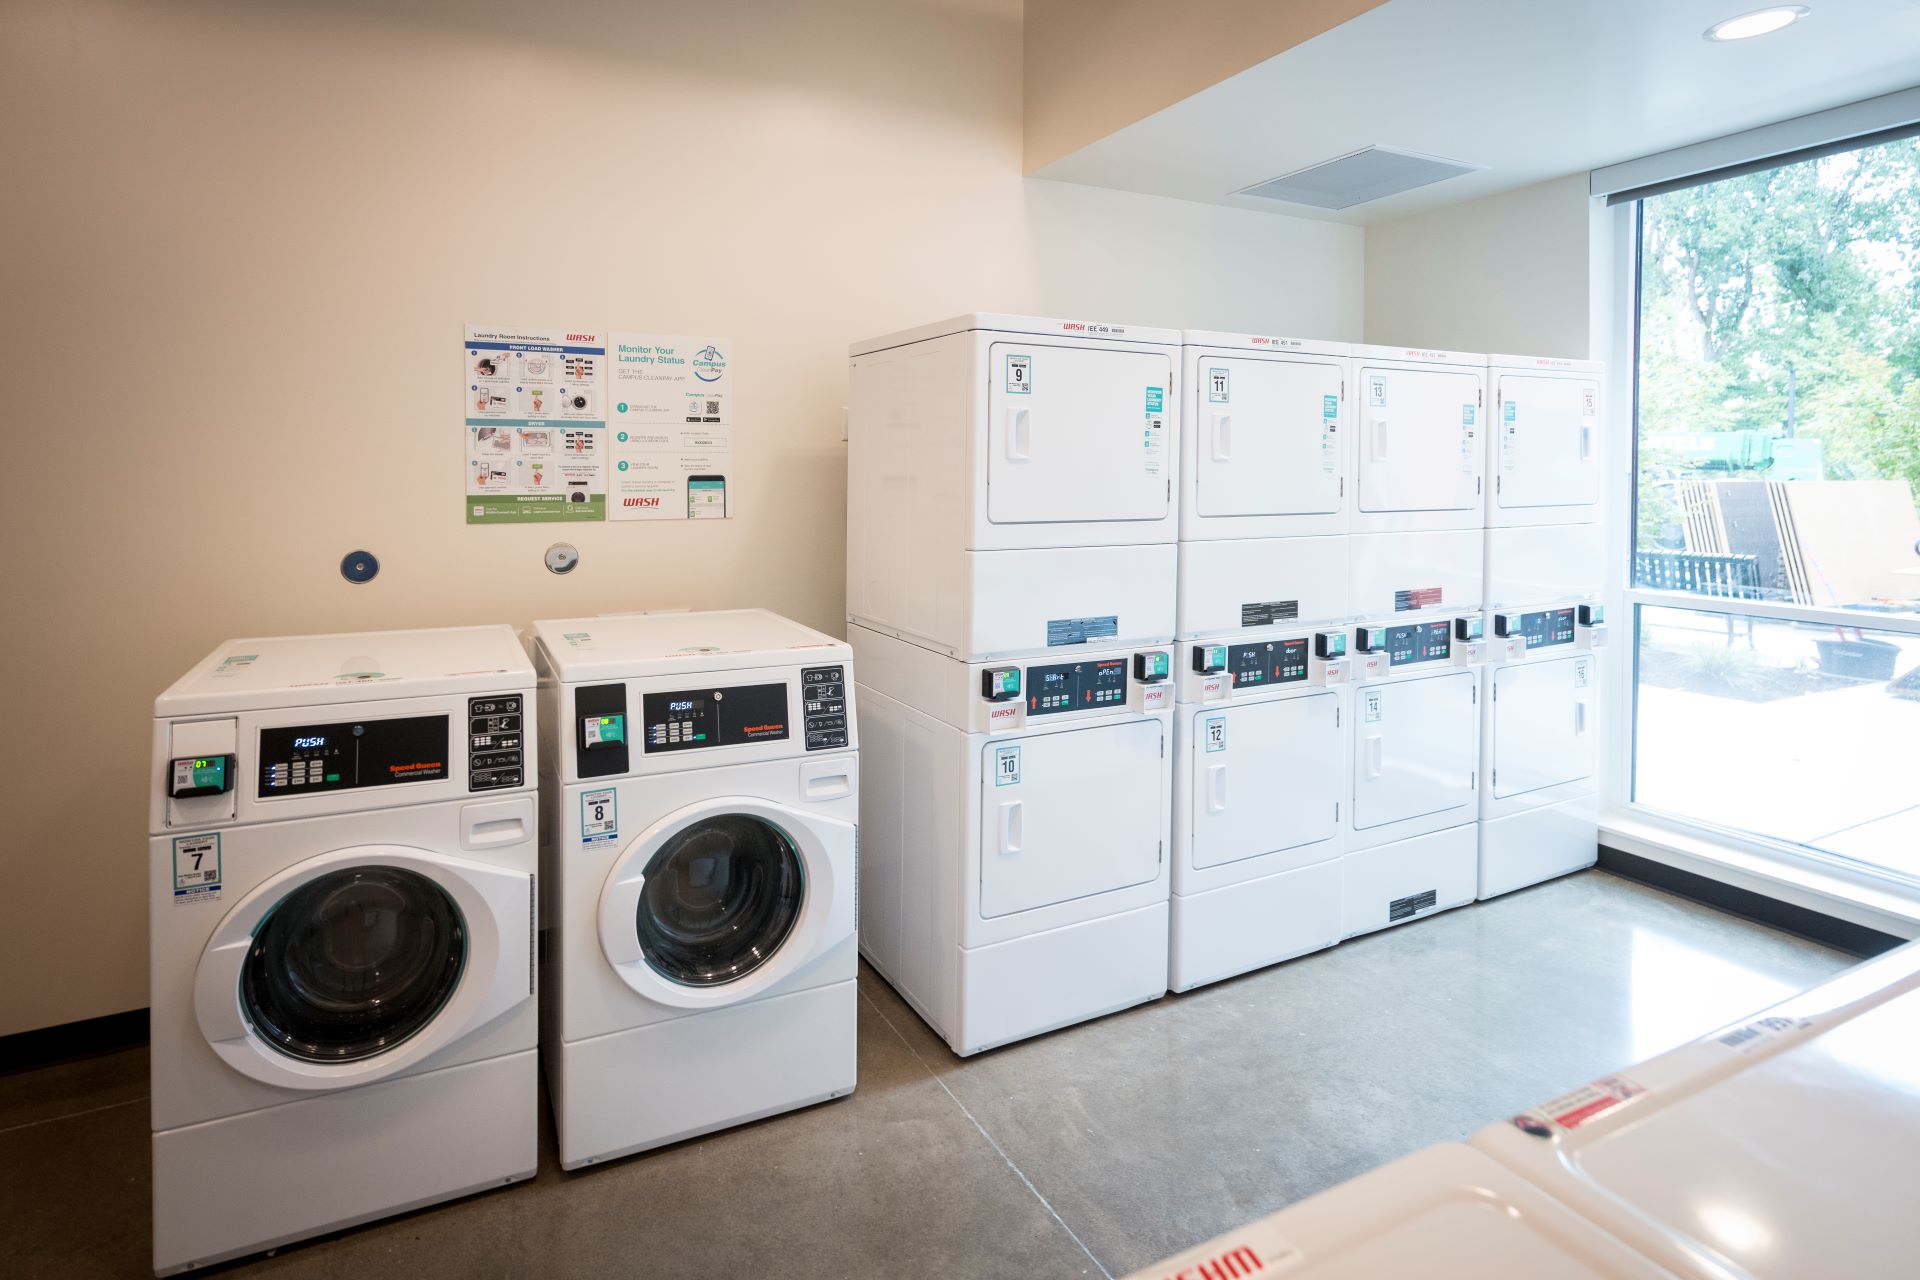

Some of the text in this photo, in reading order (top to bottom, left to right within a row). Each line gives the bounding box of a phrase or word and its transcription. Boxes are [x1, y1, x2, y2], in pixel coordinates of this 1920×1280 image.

[1063, 323, 1085, 331] WASH
[517, 334, 550, 342] Instructions
[566, 334, 595, 342] WASH
[618, 345, 674, 355] Monitor Your
[618, 355, 686, 366] Laundry Status
[693, 360, 726, 368] Campus
[1015, 368, 1022, 382] 9
[1214, 380, 1224, 392] 11
[1374, 386, 1382, 397] 13
[623, 497, 660, 507] WASH
[670, 701, 693, 710] PUSH
[1369, 702, 1378, 713] 14
[991, 708, 1016, 718] WASH
[743, 723, 784, 733] Speed Queen
[747, 731, 770, 739] Commercial
[1211, 729, 1221, 742] 12
[294, 737, 325, 747] PUSH
[196, 760, 207, 769] 07
[389, 761, 441, 773] Speed Queen
[1002, 759, 1015, 774] 10
[394, 767, 441, 778] Commercial Washer
[595, 805, 604, 821] 8
[191, 853, 203, 871] 7
